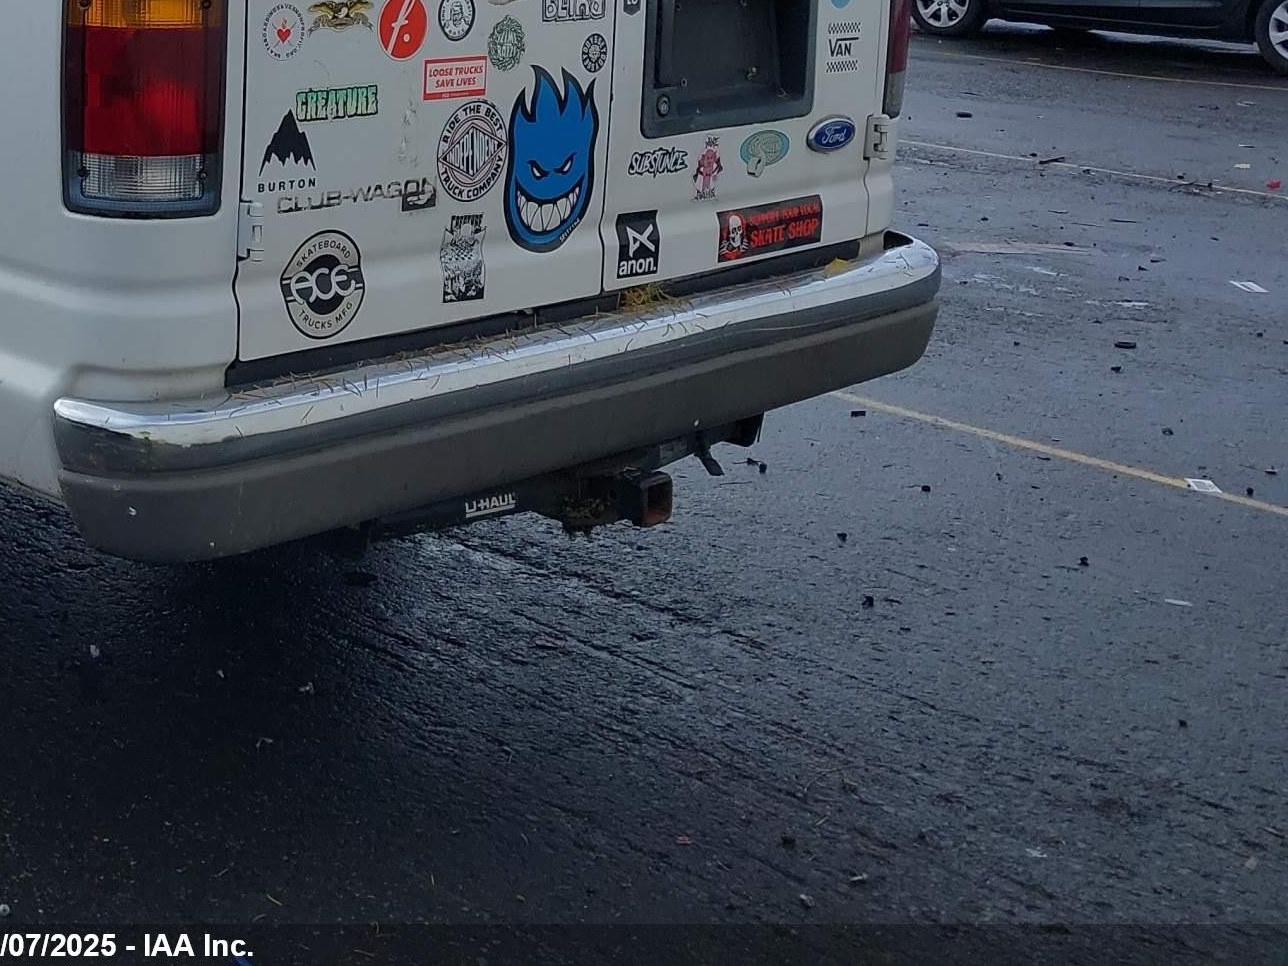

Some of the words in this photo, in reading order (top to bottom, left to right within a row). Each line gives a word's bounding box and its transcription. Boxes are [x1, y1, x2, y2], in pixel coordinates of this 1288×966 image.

[828, 37, 859, 57] VAN
[429, 68, 453, 77] LOOSE
[455, 65, 483, 75] TRUCKS
[435, 78, 454, 88] SAVE
[457, 77, 476, 86] LIVES
[296, 85, 378, 122] CREATURE
[442, 114, 461, 144] RIDE
[462, 105, 481, 115] THE
[484, 107, 503, 132] BEST
[821, 126, 847, 144] Ford
[258, 177, 316, 193] BURTON
[441, 167, 465, 198] TRUCK
[466, 155, 503, 198] COMPANY
[787, 218, 819, 240] SHOP
[296, 240, 351, 267] SKATEBOARD
[619, 257, 656, 275] anon.
[300, 310, 332, 330] TRUCKS
[335, 301, 353, 323] MFG
[465, 493, 516, 513] U-HAUL
